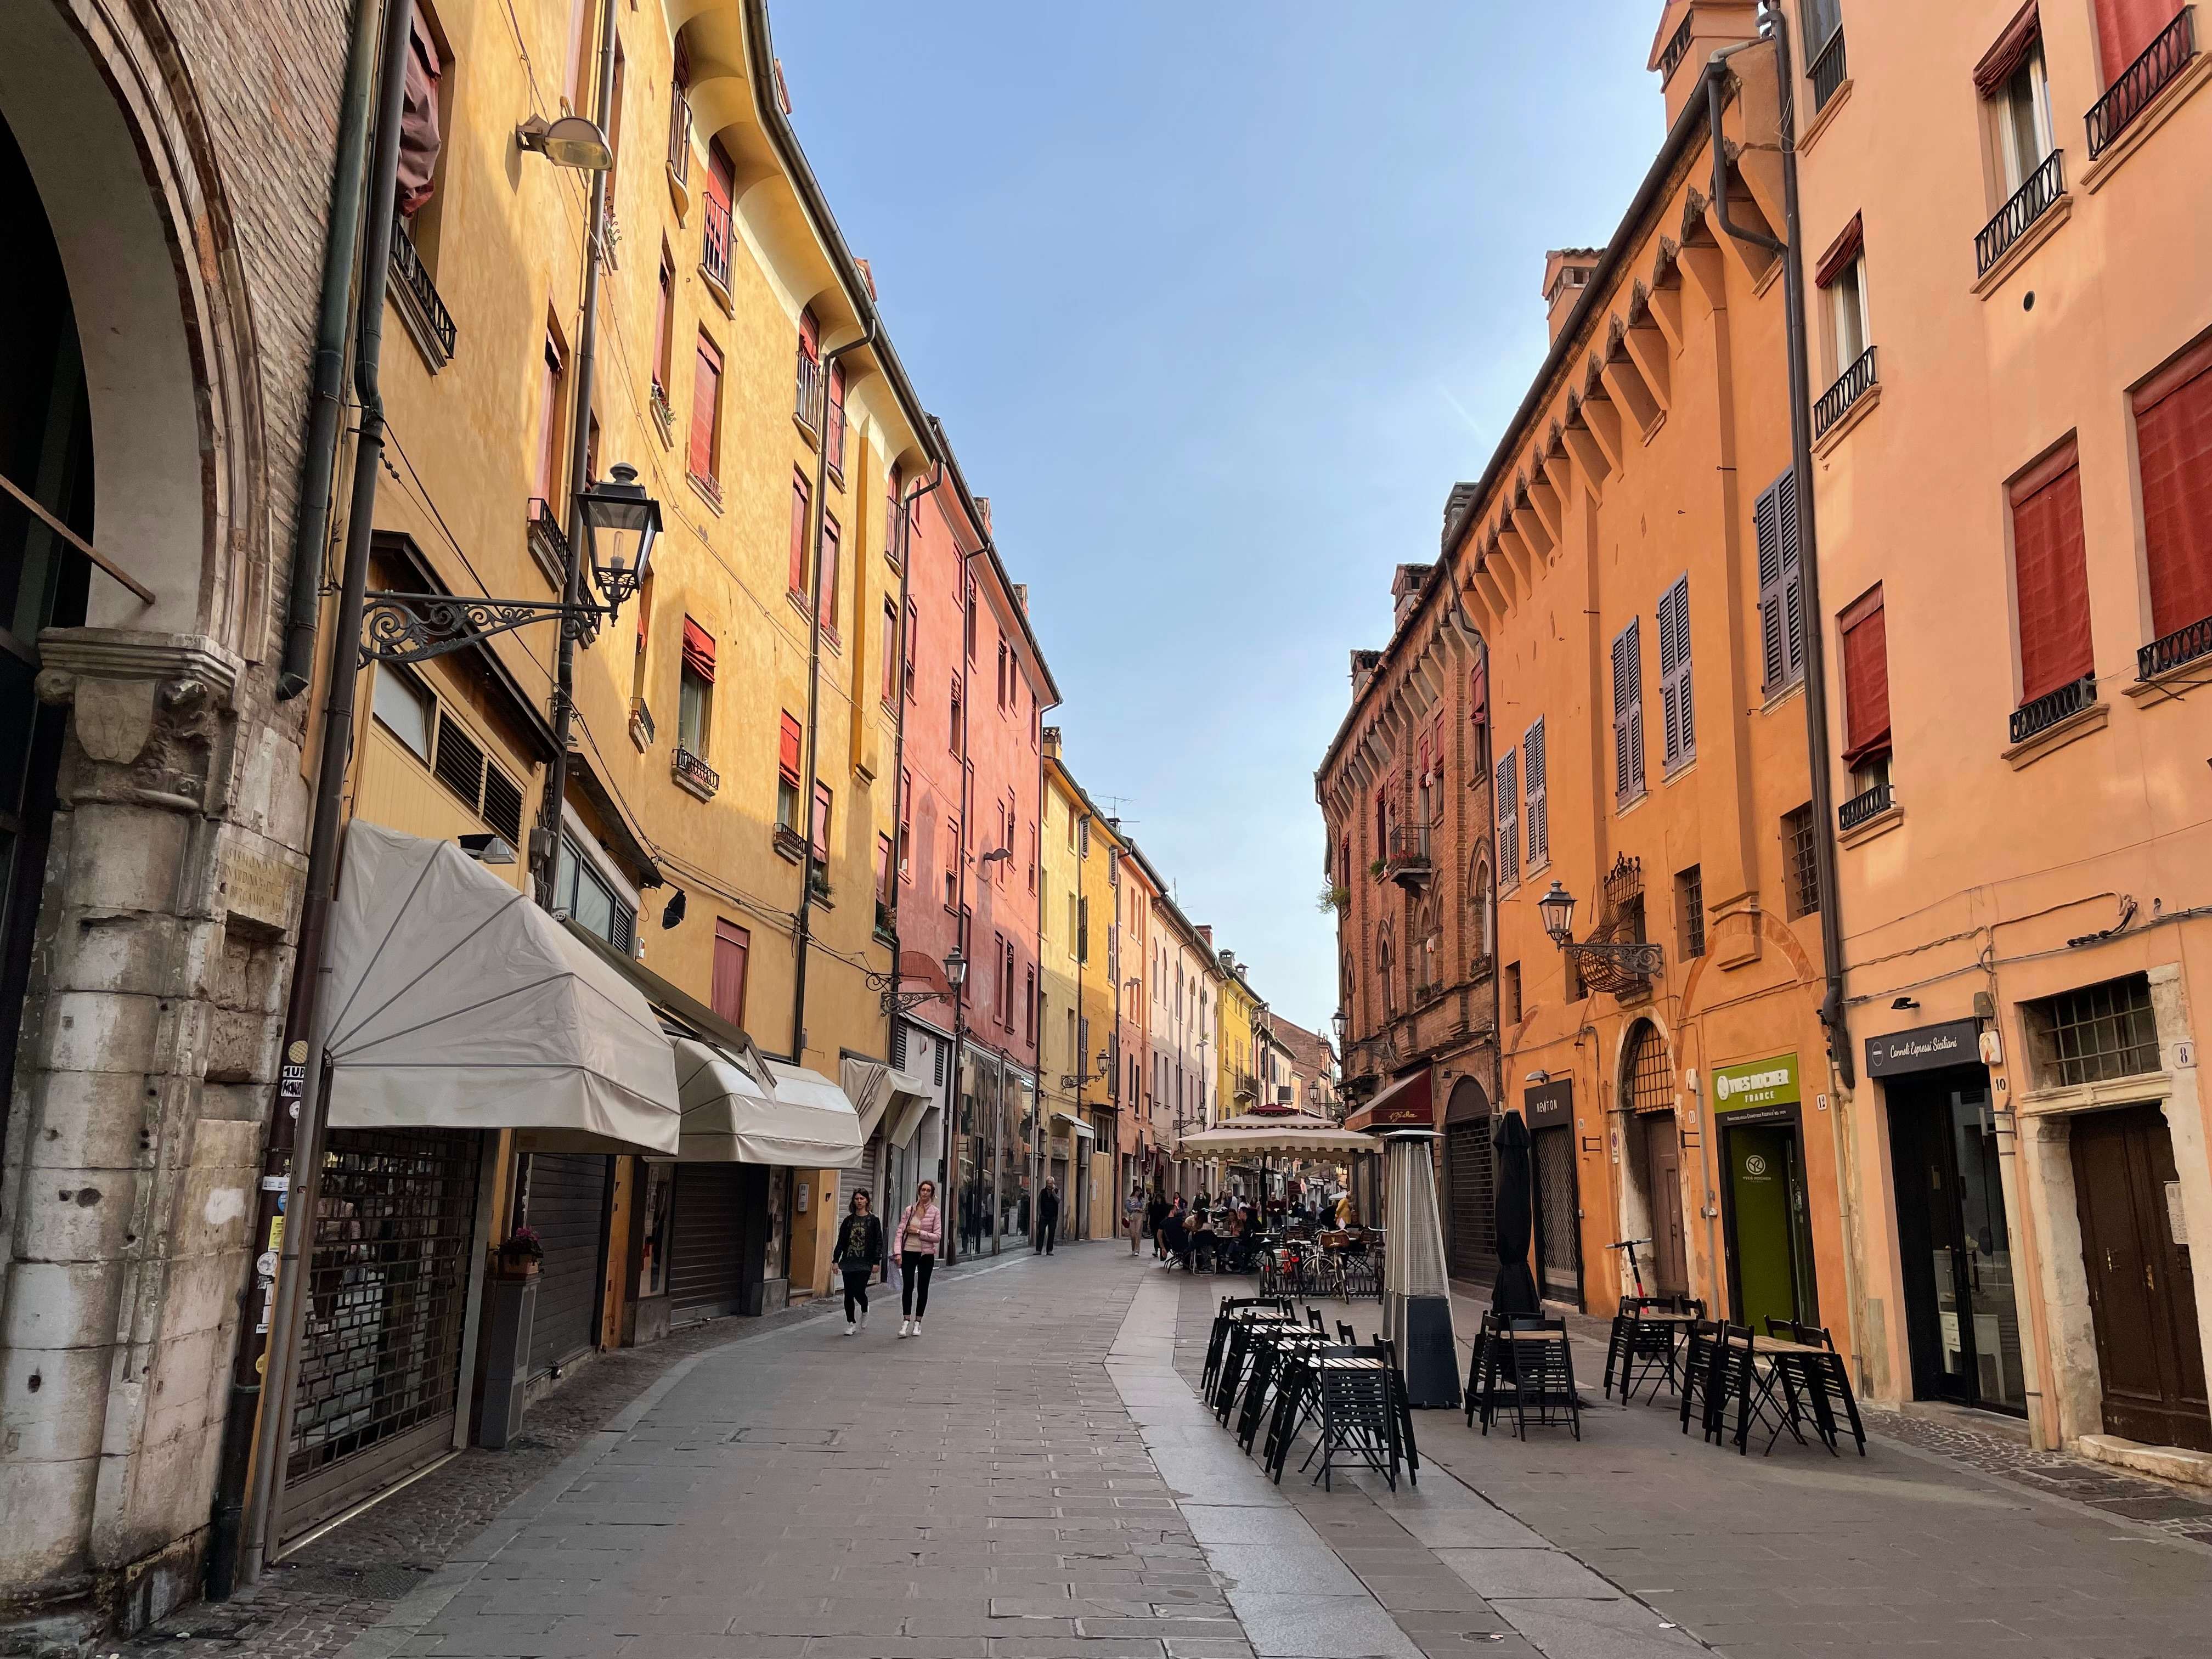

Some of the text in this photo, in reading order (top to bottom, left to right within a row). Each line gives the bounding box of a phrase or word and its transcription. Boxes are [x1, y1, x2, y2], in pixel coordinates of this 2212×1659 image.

[1890, 1035, 1957, 1058] Cannoli Espressi Siciliani
[2180, 1047, 2188, 1064] 8
[1995, 1078, 2006, 1091] 10
[1745, 1091, 1775, 1103] FRANCE
[1818, 1096, 1826, 1108] 12
[1536, 1098, 1558, 1113] NEWTON
